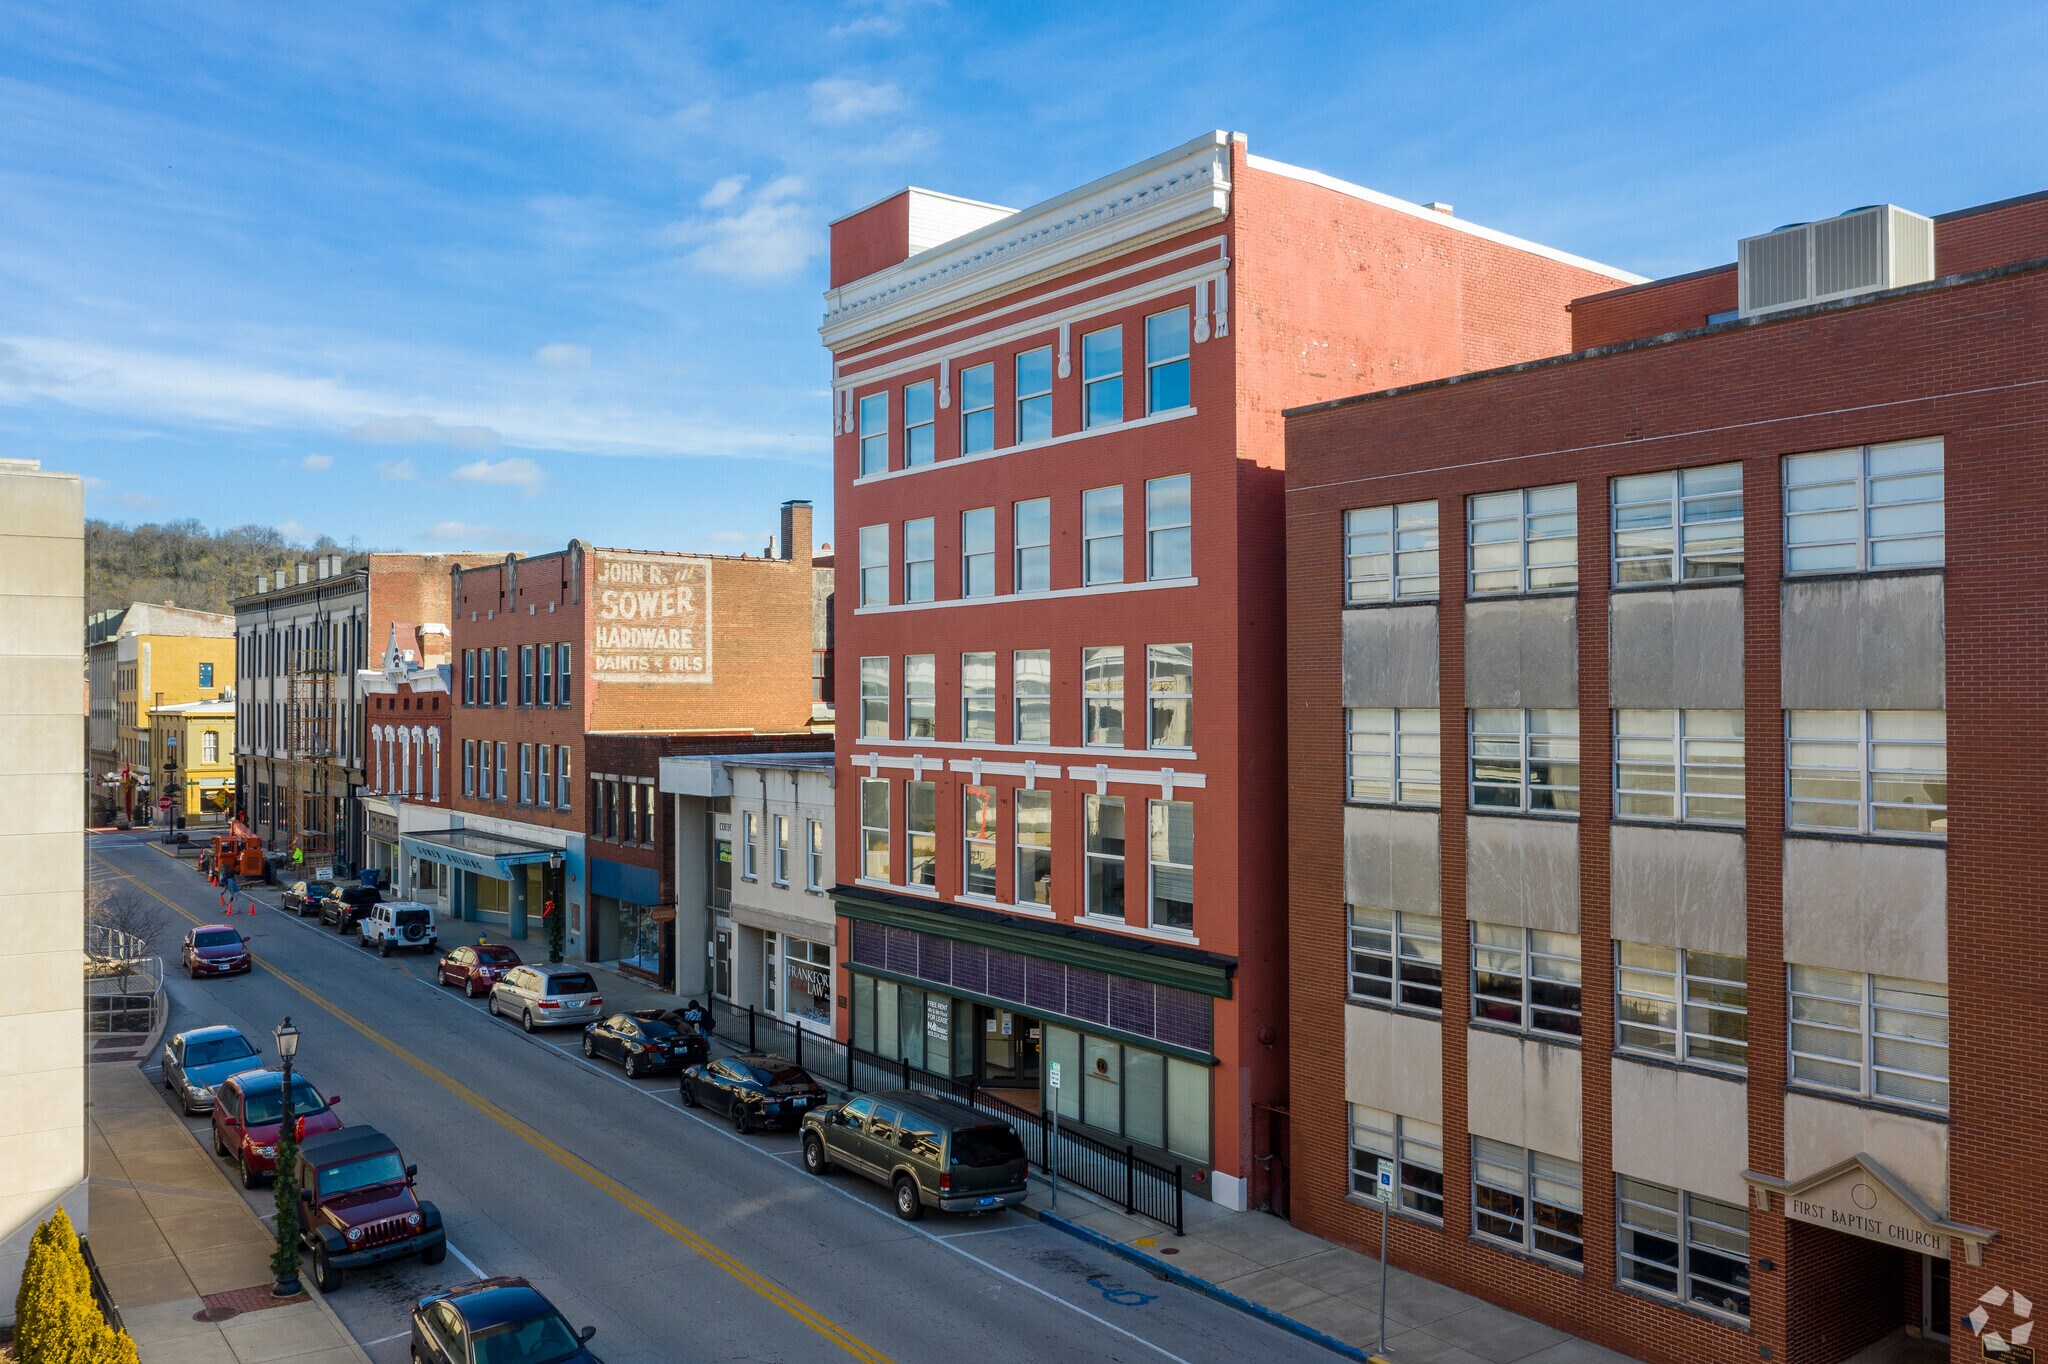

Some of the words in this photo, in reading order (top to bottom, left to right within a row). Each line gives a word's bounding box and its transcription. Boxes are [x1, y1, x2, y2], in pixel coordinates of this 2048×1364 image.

[597, 562, 643, 583] JOHN
[650, 565, 668, 585] R.
[600, 586, 695, 619] SOWER
[596, 626, 692, 649] HARDWARE
[596, 655, 649, 670] PAINTS
[669, 656, 703, 671] OILS
[446, 854, 482, 870] BUILDING
[807, 981, 824, 998] LAW
[928, 1000, 938, 1008] FREE
[938, 1002, 948, 1011] RENT
[936, 1016, 948, 1024] LEASE
[1793, 1200, 1825, 1220] FIRST
[1832, 1209, 1882, 1234] BAPTIST
[1888, 1224, 1940, 1250] CHURCH
